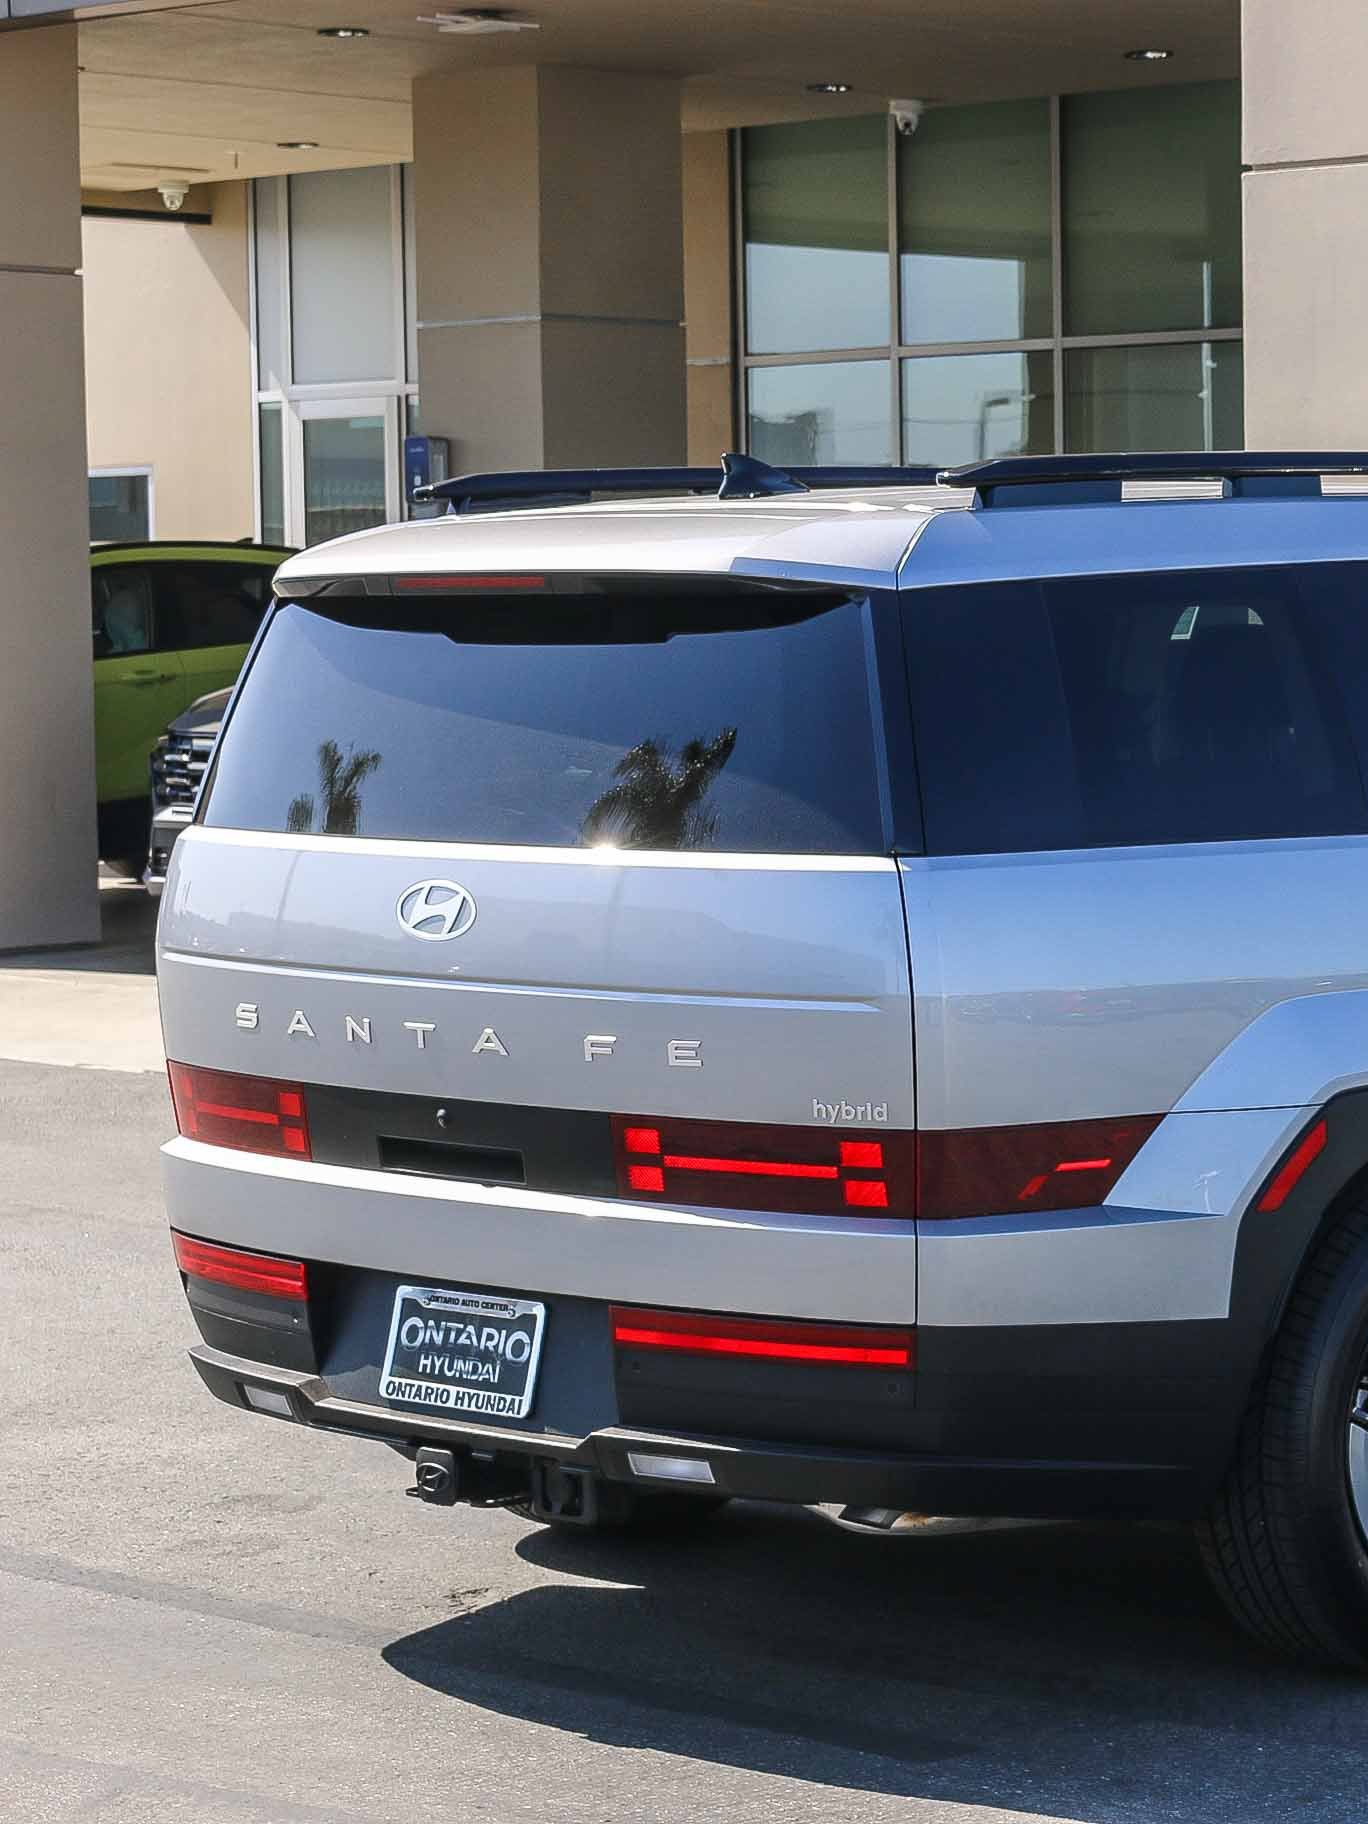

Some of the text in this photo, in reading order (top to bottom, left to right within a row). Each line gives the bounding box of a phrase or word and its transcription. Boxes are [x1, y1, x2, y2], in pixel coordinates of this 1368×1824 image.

[235, 1003, 702, 1067] SANTA FE
[812, 1099, 889, 1123] hybrid
[430, 1295, 460, 1306] ONTARIO
[461, 1298, 480, 1308] AUTO
[401, 1317, 531, 1362] ONTARIO
[419, 1354, 501, 1383] HYUNDAI
[386, 1381, 523, 1415] ONTARIO HYUNDAI
